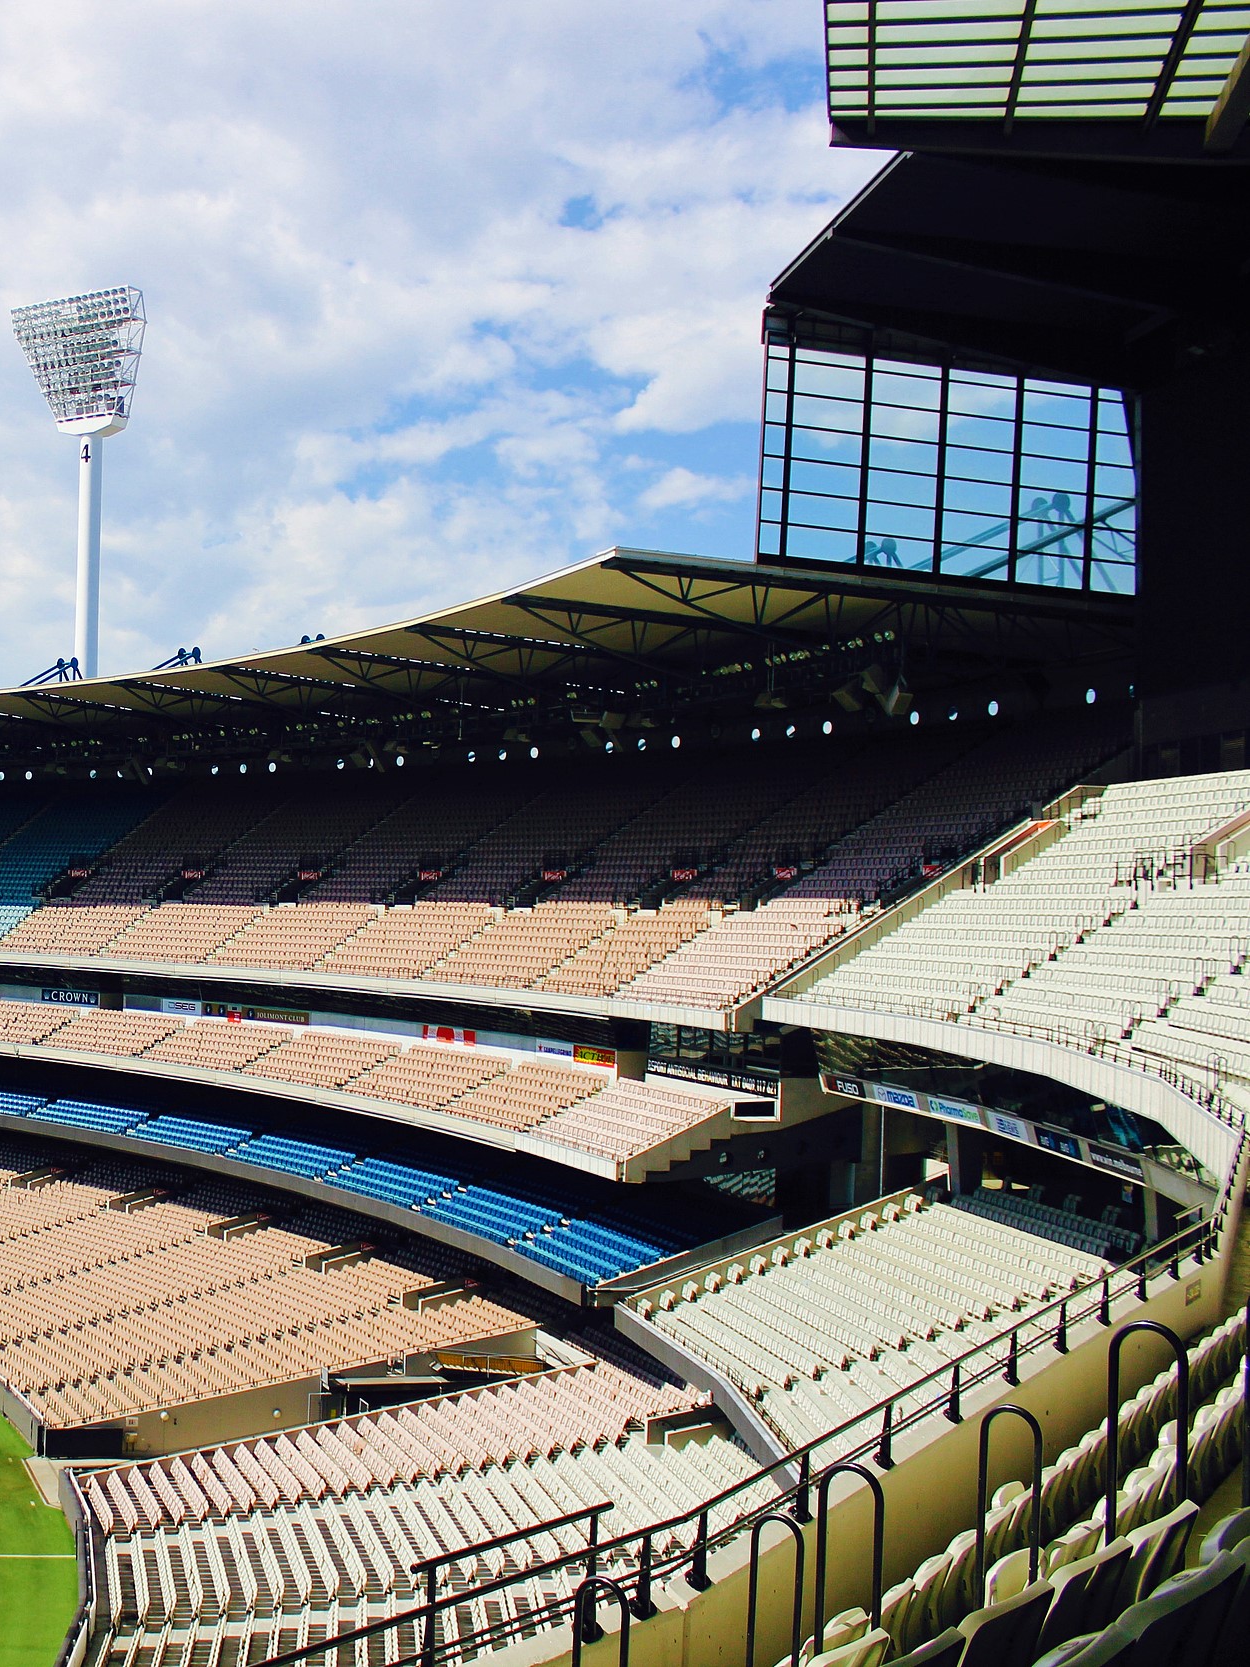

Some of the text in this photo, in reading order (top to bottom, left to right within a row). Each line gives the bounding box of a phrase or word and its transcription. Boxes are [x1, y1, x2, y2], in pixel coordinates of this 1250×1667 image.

[81, 444, 91, 463] 4
[51, 990, 89, 1003] CROWN
[257, 1012, 306, 1023] JOLIMONT CLUB
[647, 1059, 668, 1074] REPORT
[667, 1063, 698, 1080] ANTISOCIAL
[697, 1068, 729, 1086] BEHAVIOUR
[837, 1080, 860, 1095] FUSO
[939, 1103, 980, 1121] PharmaSave
